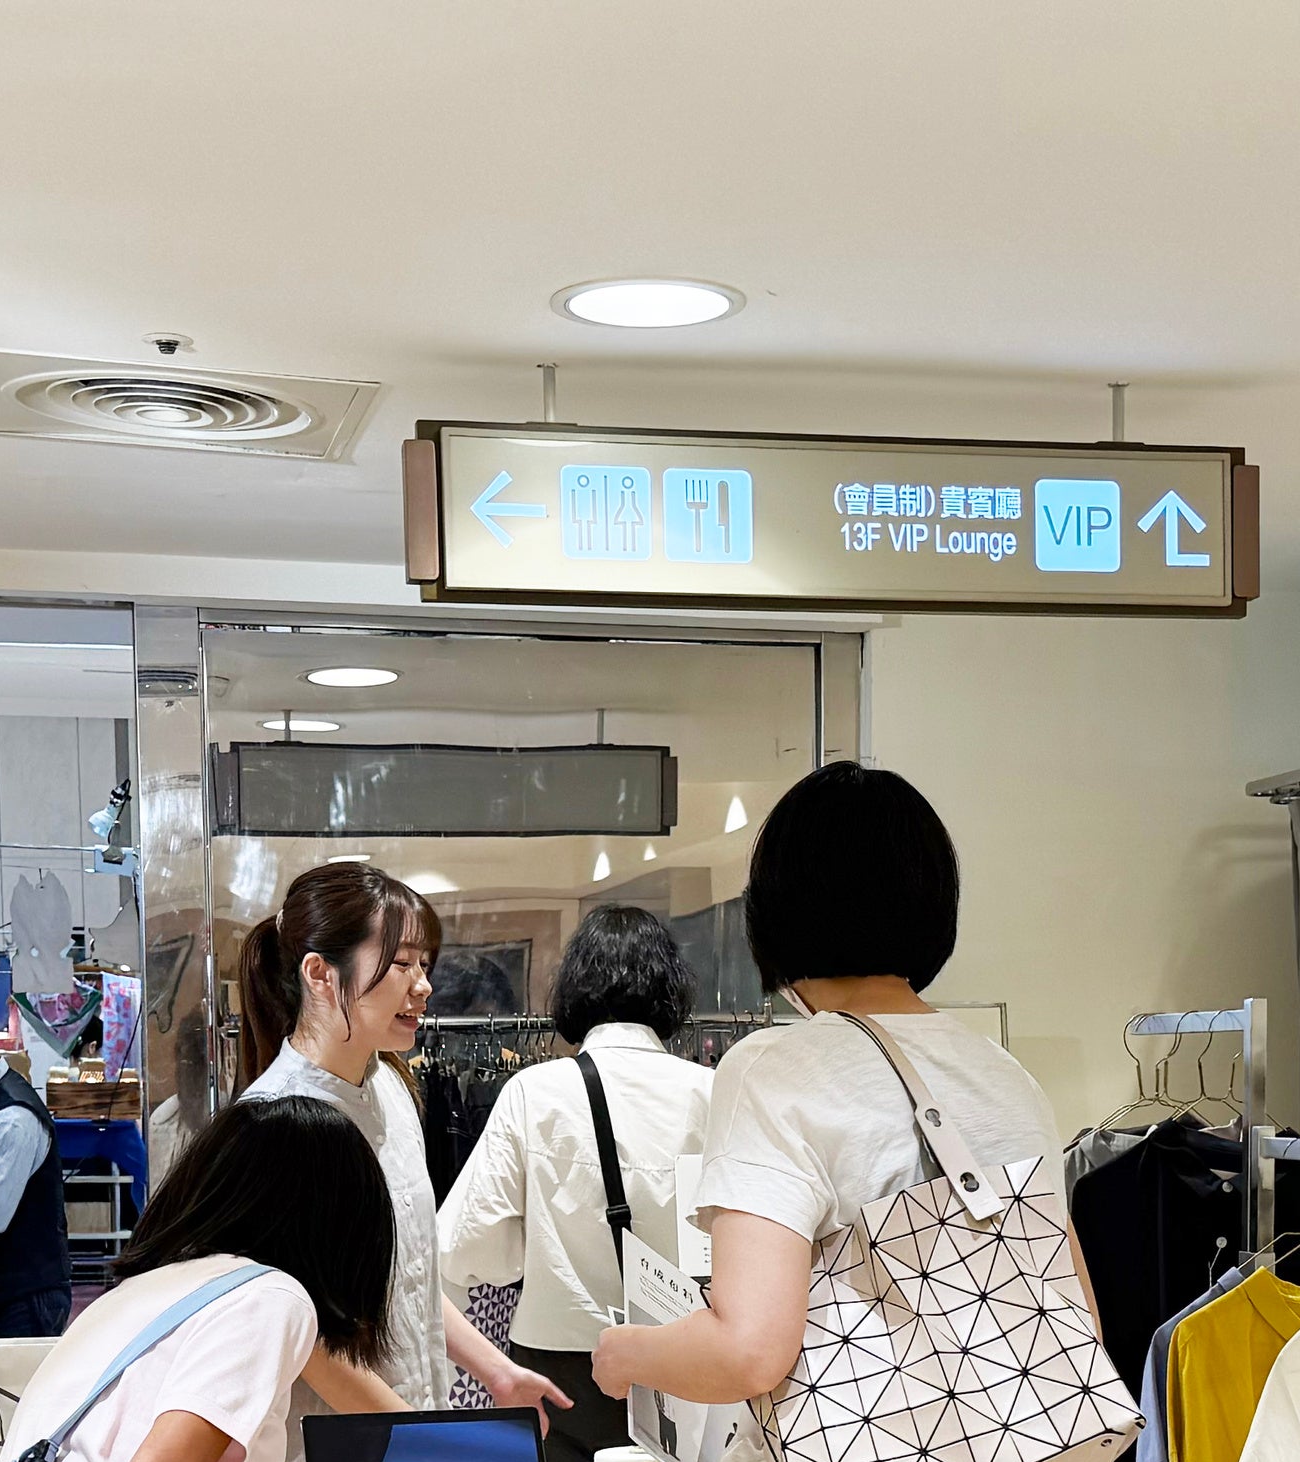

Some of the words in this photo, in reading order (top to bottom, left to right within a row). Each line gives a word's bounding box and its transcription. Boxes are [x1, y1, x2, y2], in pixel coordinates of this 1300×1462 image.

[840, 522, 882, 551] 13F
[888, 523, 929, 553] VIP
[935, 524, 1017, 562] Lounge
[1043, 505, 1113, 547] VIP
